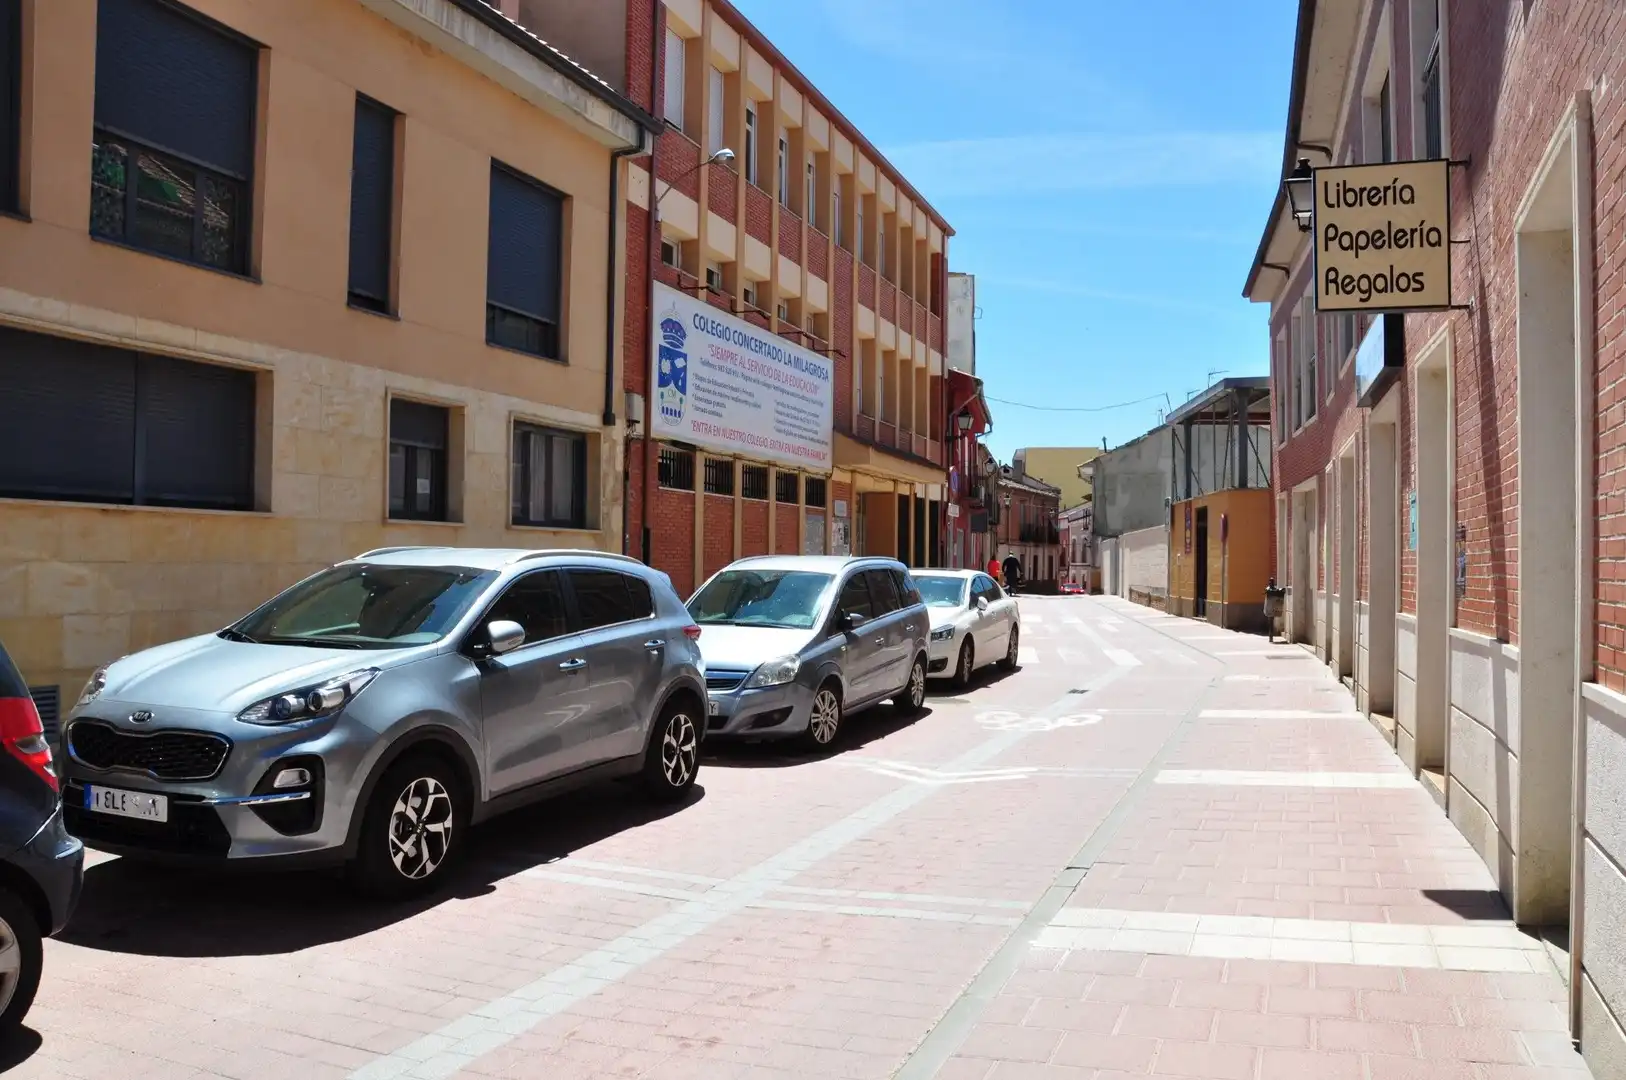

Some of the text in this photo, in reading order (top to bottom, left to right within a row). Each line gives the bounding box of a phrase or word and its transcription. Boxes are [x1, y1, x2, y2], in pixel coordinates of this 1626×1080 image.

[1324, 177, 1415, 209] Librería
[1324, 219, 1442, 259] Papelería
[1325, 264, 1425, 303] Regalos
[693, 313, 731, 342] COLEGIO
[733, 330, 783, 363] CONCERTADO
[783, 352, 793, 367] LA
[793, 355, 830, 382] MILAGROSA
[739, 355, 747, 370] AL
[747, 358, 774, 379] SERVICIO
[774, 367, 782, 382] DE
[712, 424, 722, 438] EN
[721, 427, 746, 443] NUESTRO
[133, 711, 150, 720] KIA
